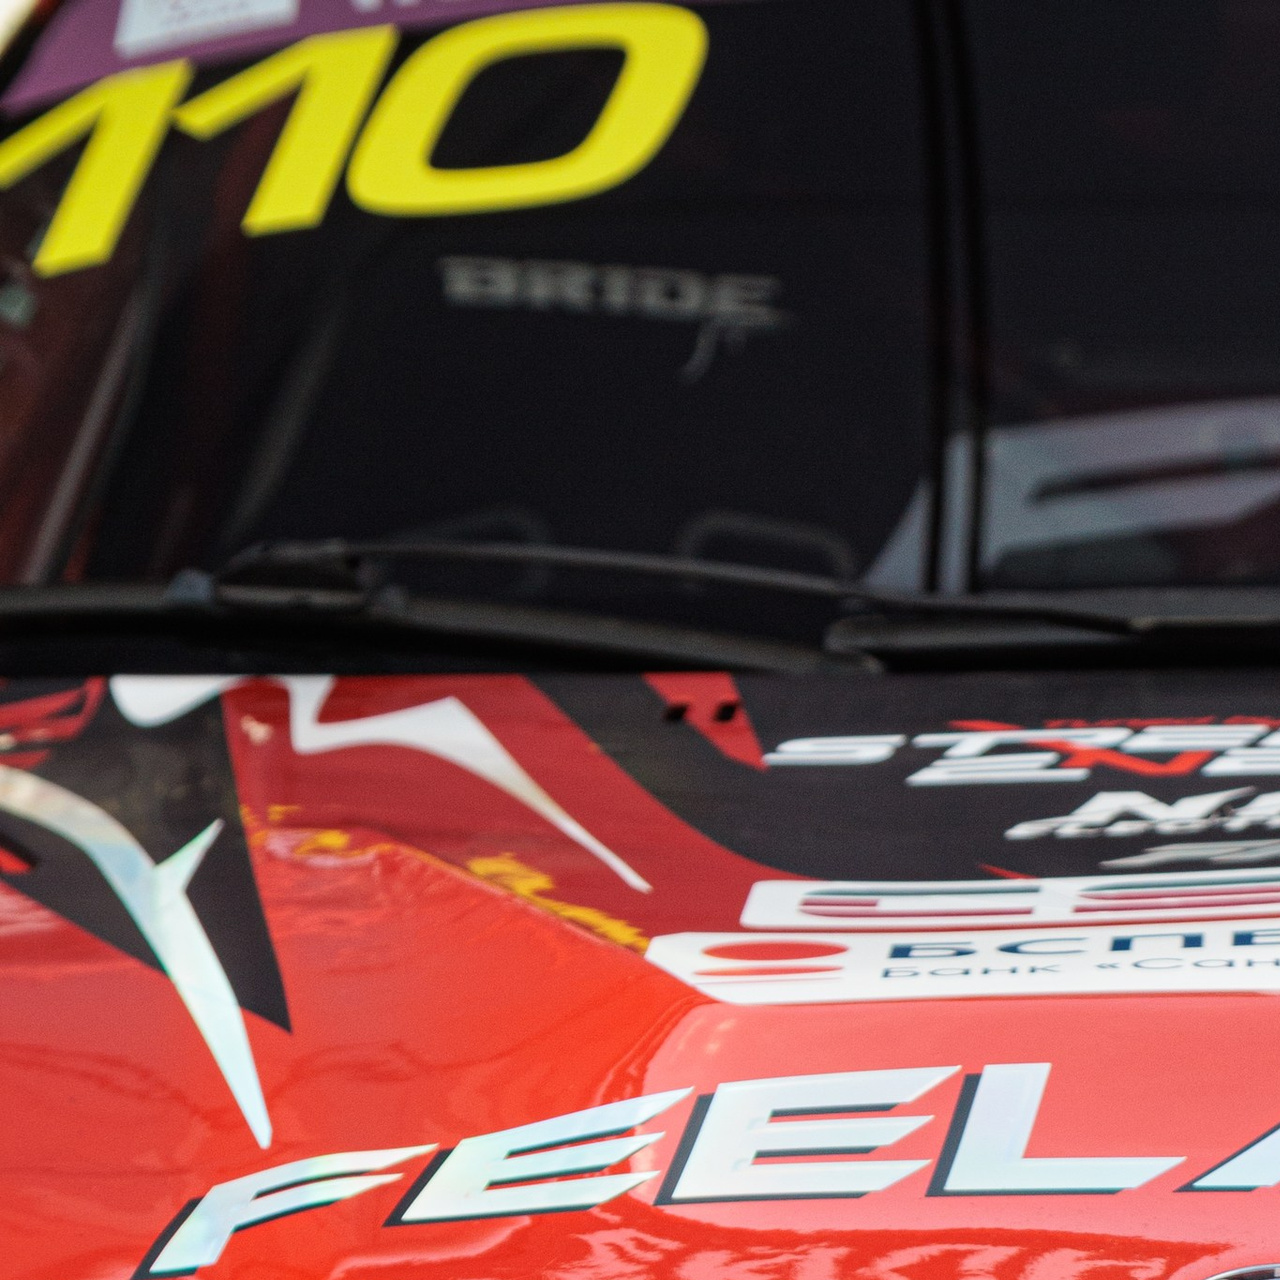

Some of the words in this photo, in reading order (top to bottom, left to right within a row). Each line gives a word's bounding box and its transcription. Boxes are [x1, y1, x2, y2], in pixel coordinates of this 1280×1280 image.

[0, 2, 708, 277] 110
[438, 254, 788, 330] BRIDE
[881, 961, 1062, 979] Банк
